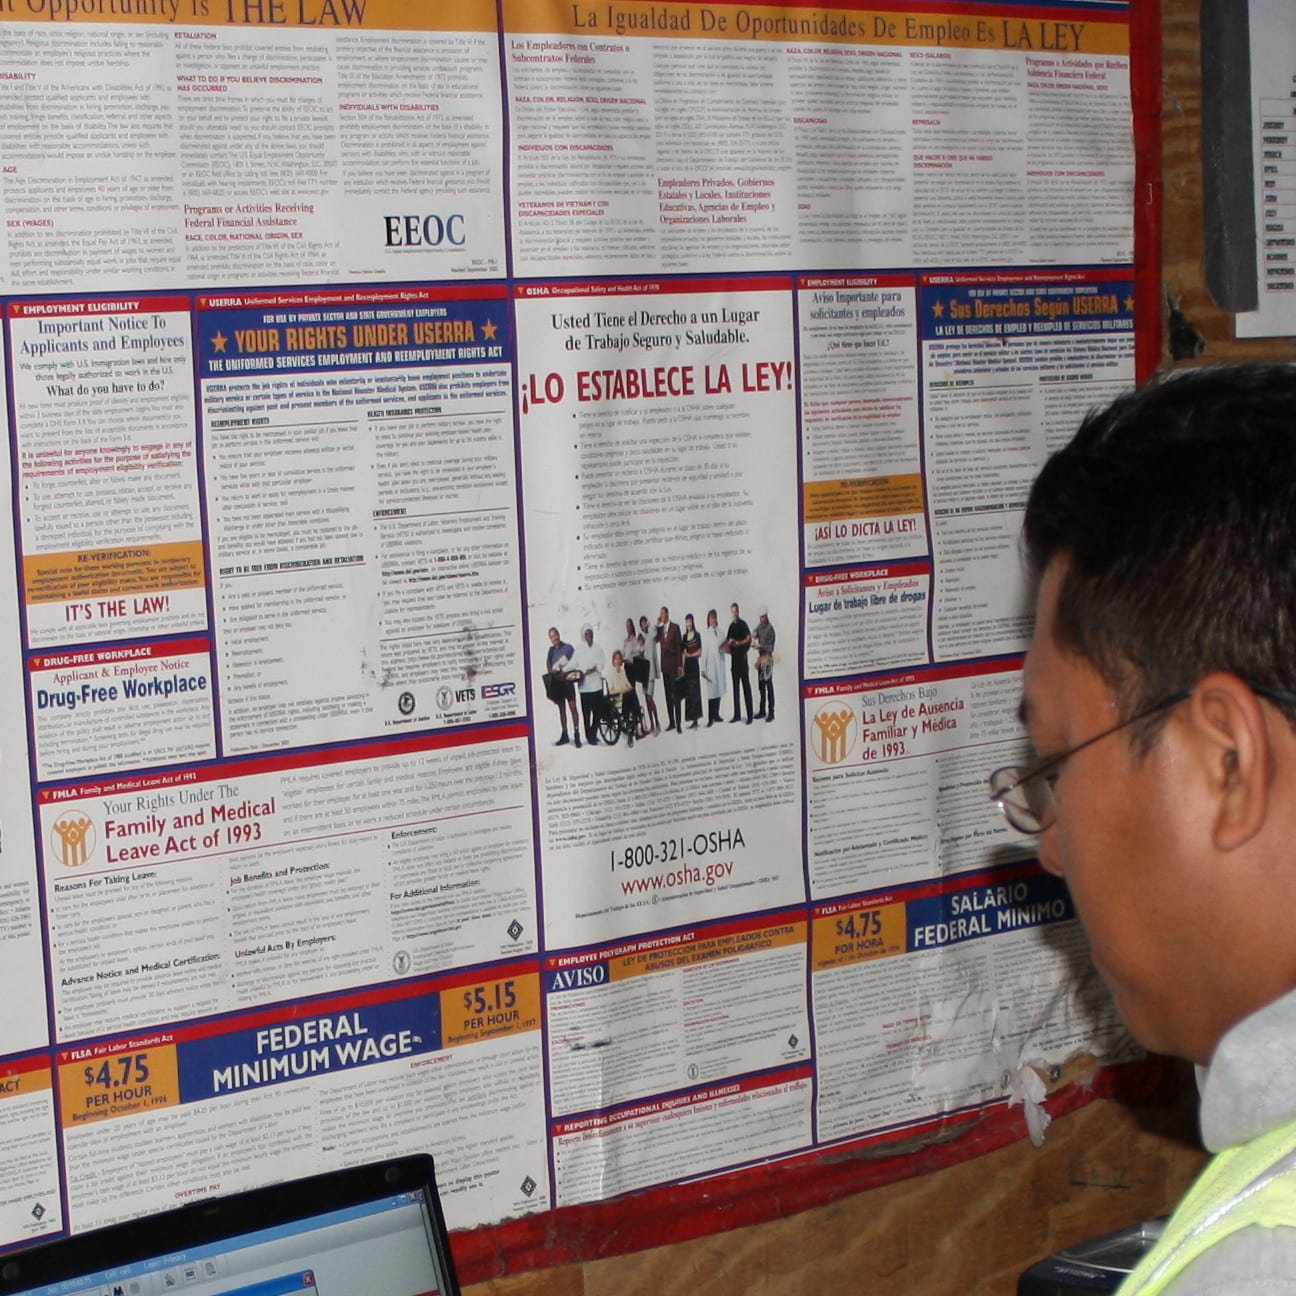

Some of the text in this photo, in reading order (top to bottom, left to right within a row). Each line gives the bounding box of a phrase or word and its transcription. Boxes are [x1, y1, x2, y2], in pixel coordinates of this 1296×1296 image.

[226, 0, 288, 24] THE
[296, 0, 367, 25] LAW
[573, 6, 1085, 51] La Igualdad De Oportunidades De Empleo Es LA LEY
[384, 215, 465, 246] EEOC
[23, 301, 140, 314] EMPLOYMENT ELIGIBILITY
[552, 307, 760, 329] Usted Tiene el Derecho a un Lugar
[38, 315, 166, 336] Important Notice To
[235, 319, 474, 353] YOUR RIGHTS UNDER USERRA
[20, 335, 184, 357] Applicants and Employees
[565, 329, 750, 352] de Trabajo Seguro y Saludable.
[522, 372, 564, 415] ¡LO
[577, 366, 694, 402] ESTABLECE
[705, 363, 732, 394] LA
[743, 361, 793, 393] LEY!
[66, 596, 170, 622] IT'S THE LAW!
[44, 647, 151, 667] DRUG-FREE WORKPLACE
[53, 659, 190, 685] Applicant & Employee Notice
[37, 675, 206, 710] Drug-Free Workplace
[456, 689, 475, 702] VETS
[863, 697, 964, 727] La Ley de Ausencia
[863, 717, 957, 743] Familiar y Médica
[863, 742, 905, 760] de 1993
[103, 784, 239, 816] Your Rights Under The
[105, 797, 276, 840] Family and Medical
[106, 822, 261, 863] Leave Act of 1993
[611, 827, 745, 872] 1-800-321-OSHA
[54, 871, 157, 893] Reasons For Taking Leave:
[621, 861, 733, 895] www.osha.gov
[951, 883, 1028, 915] SALARIO
[836, 910, 882, 939] $4.75
[914, 913, 991, 947] FEDERAL
[553, 965, 604, 991] AVISO
[463, 981, 517, 1014] $5.15
[256, 1012, 368, 1054] FEDERAL
[464, 1010, 519, 1031] PER HOUR
[85, 1054, 149, 1088] $4.75
[213, 1030, 412, 1092] MINIMUM WAGE
[86, 1085, 152, 1108] PER HOUR
